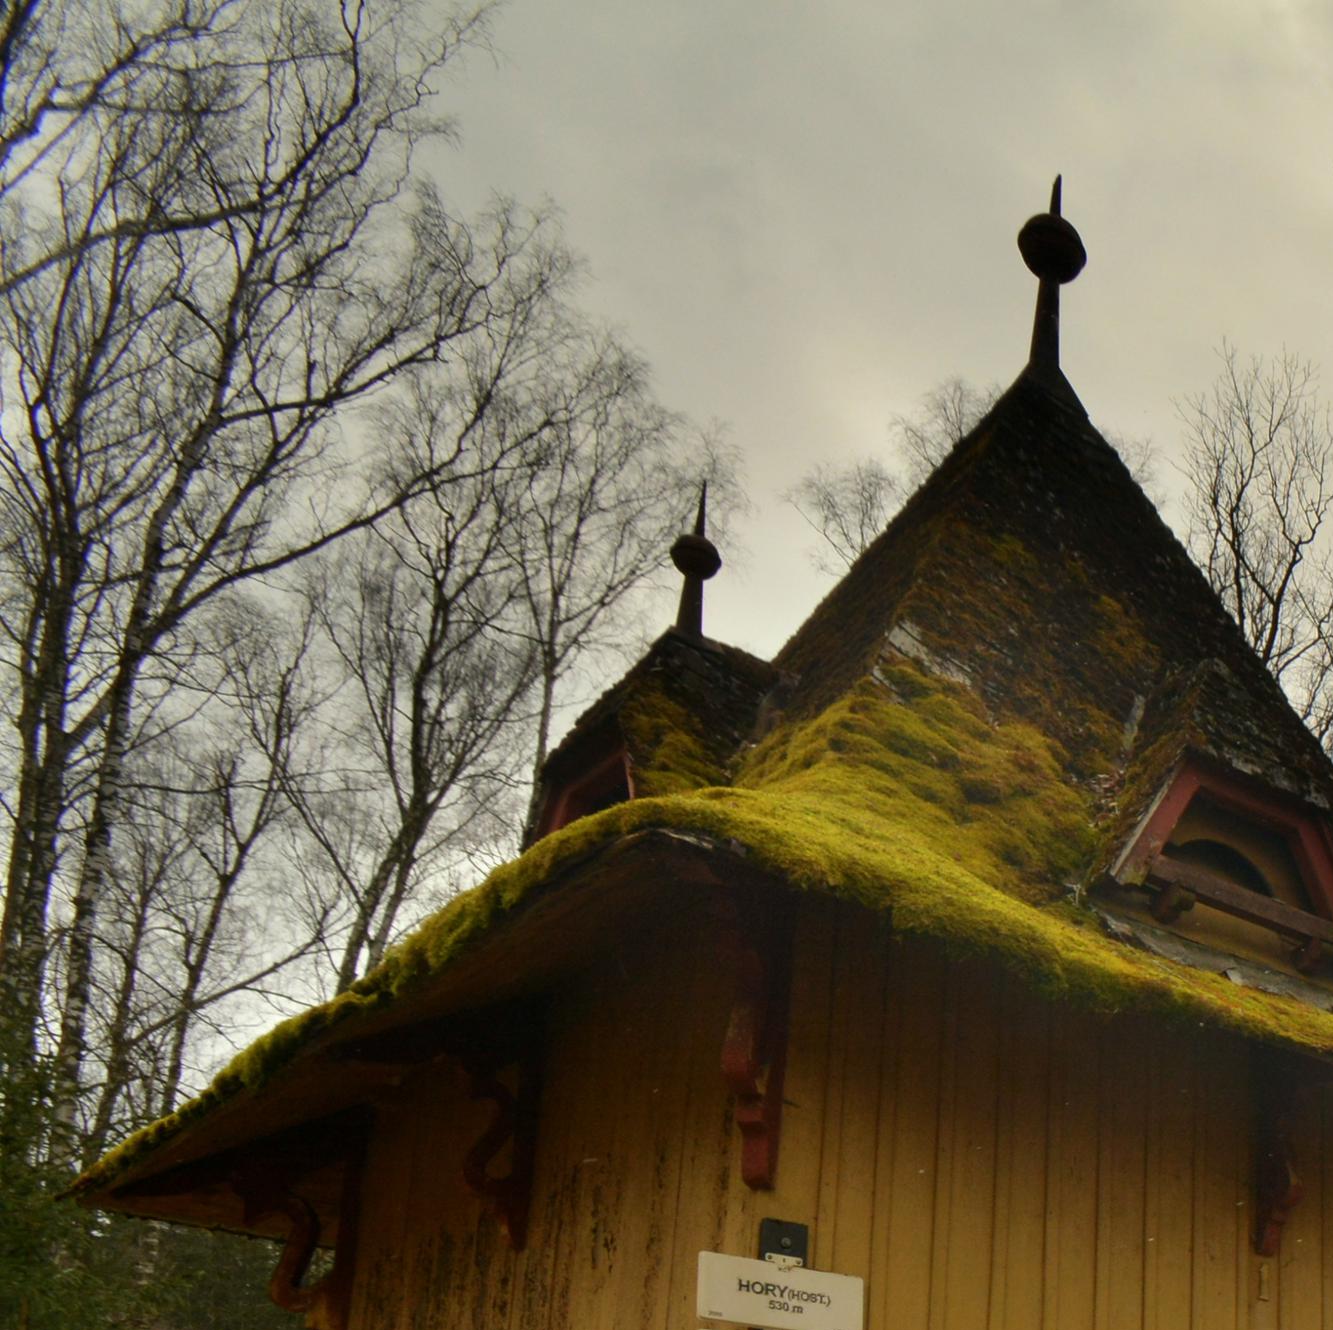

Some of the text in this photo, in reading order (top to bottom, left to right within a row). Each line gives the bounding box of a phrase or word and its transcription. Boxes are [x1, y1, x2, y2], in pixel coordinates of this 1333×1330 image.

[737, 1278, 788, 1299] HORY
[768, 1300, 804, 1314] 530 m
